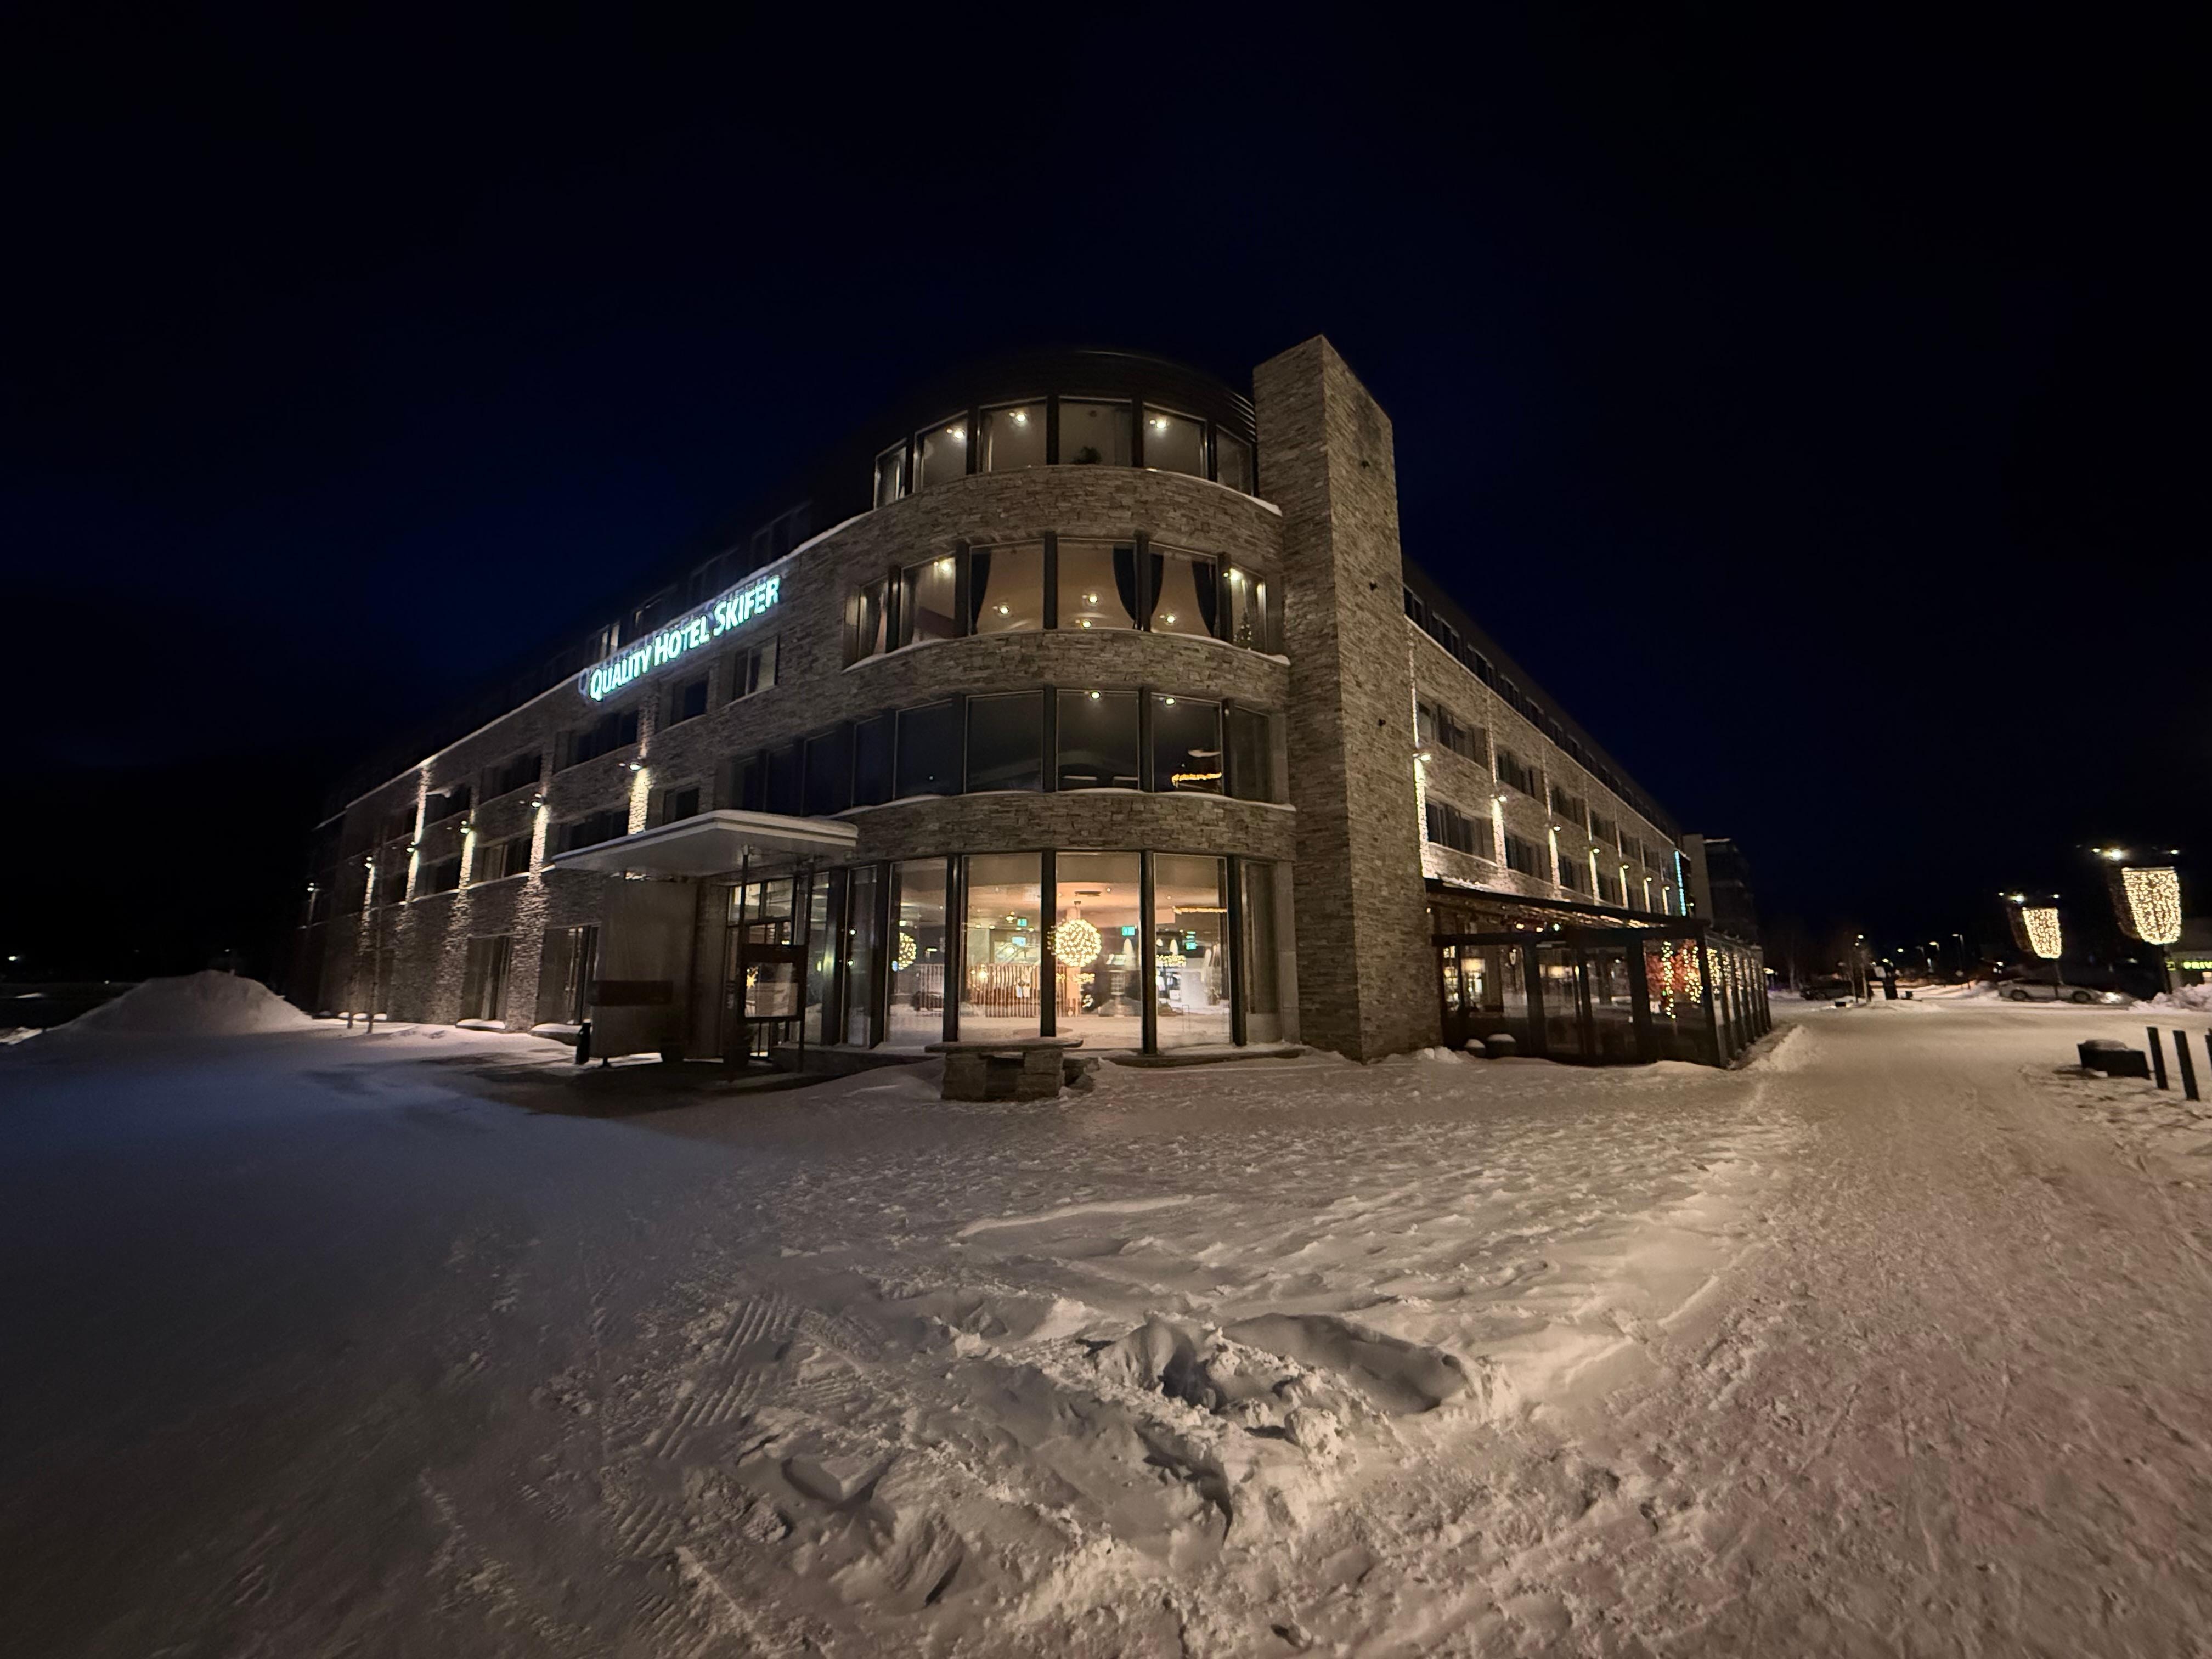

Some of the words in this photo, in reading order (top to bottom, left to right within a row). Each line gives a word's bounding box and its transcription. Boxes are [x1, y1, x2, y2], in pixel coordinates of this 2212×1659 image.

[589, 645, 652, 701] QUALITY
[654, 615, 710, 665] HOTEL
[713, 575, 781, 636] SKIFER
